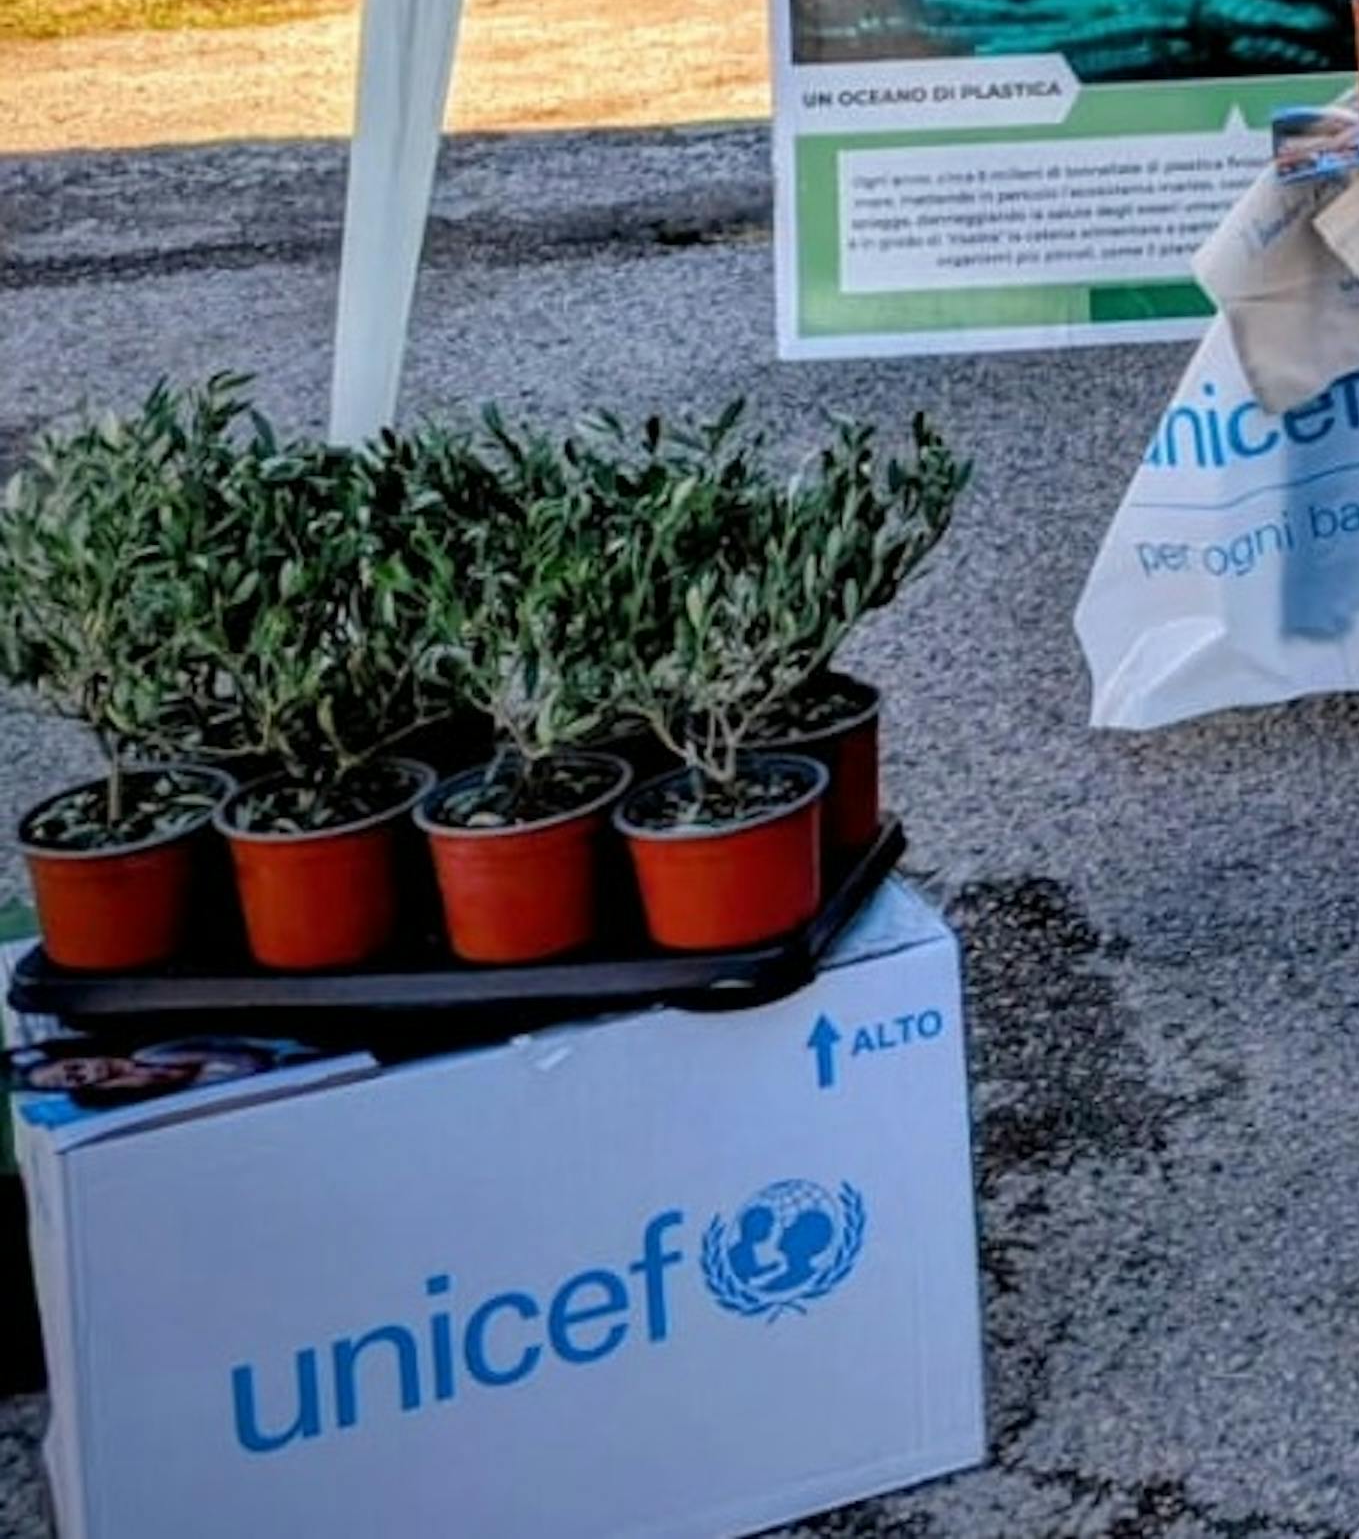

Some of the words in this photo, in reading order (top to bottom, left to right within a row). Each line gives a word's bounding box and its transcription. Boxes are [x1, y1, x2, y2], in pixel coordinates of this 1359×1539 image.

[803, 91, 832, 108] UN
[838, 87, 927, 107] OCEANO
[933, 86, 954, 102] DI
[961, 81, 1062, 100] PLASTICA
[1135, 540, 1188, 578] per
[1203, 508, 1295, 579] ogni
[850, 1008, 944, 1057] ALTO
[231, 1210, 685, 1454] unicef
